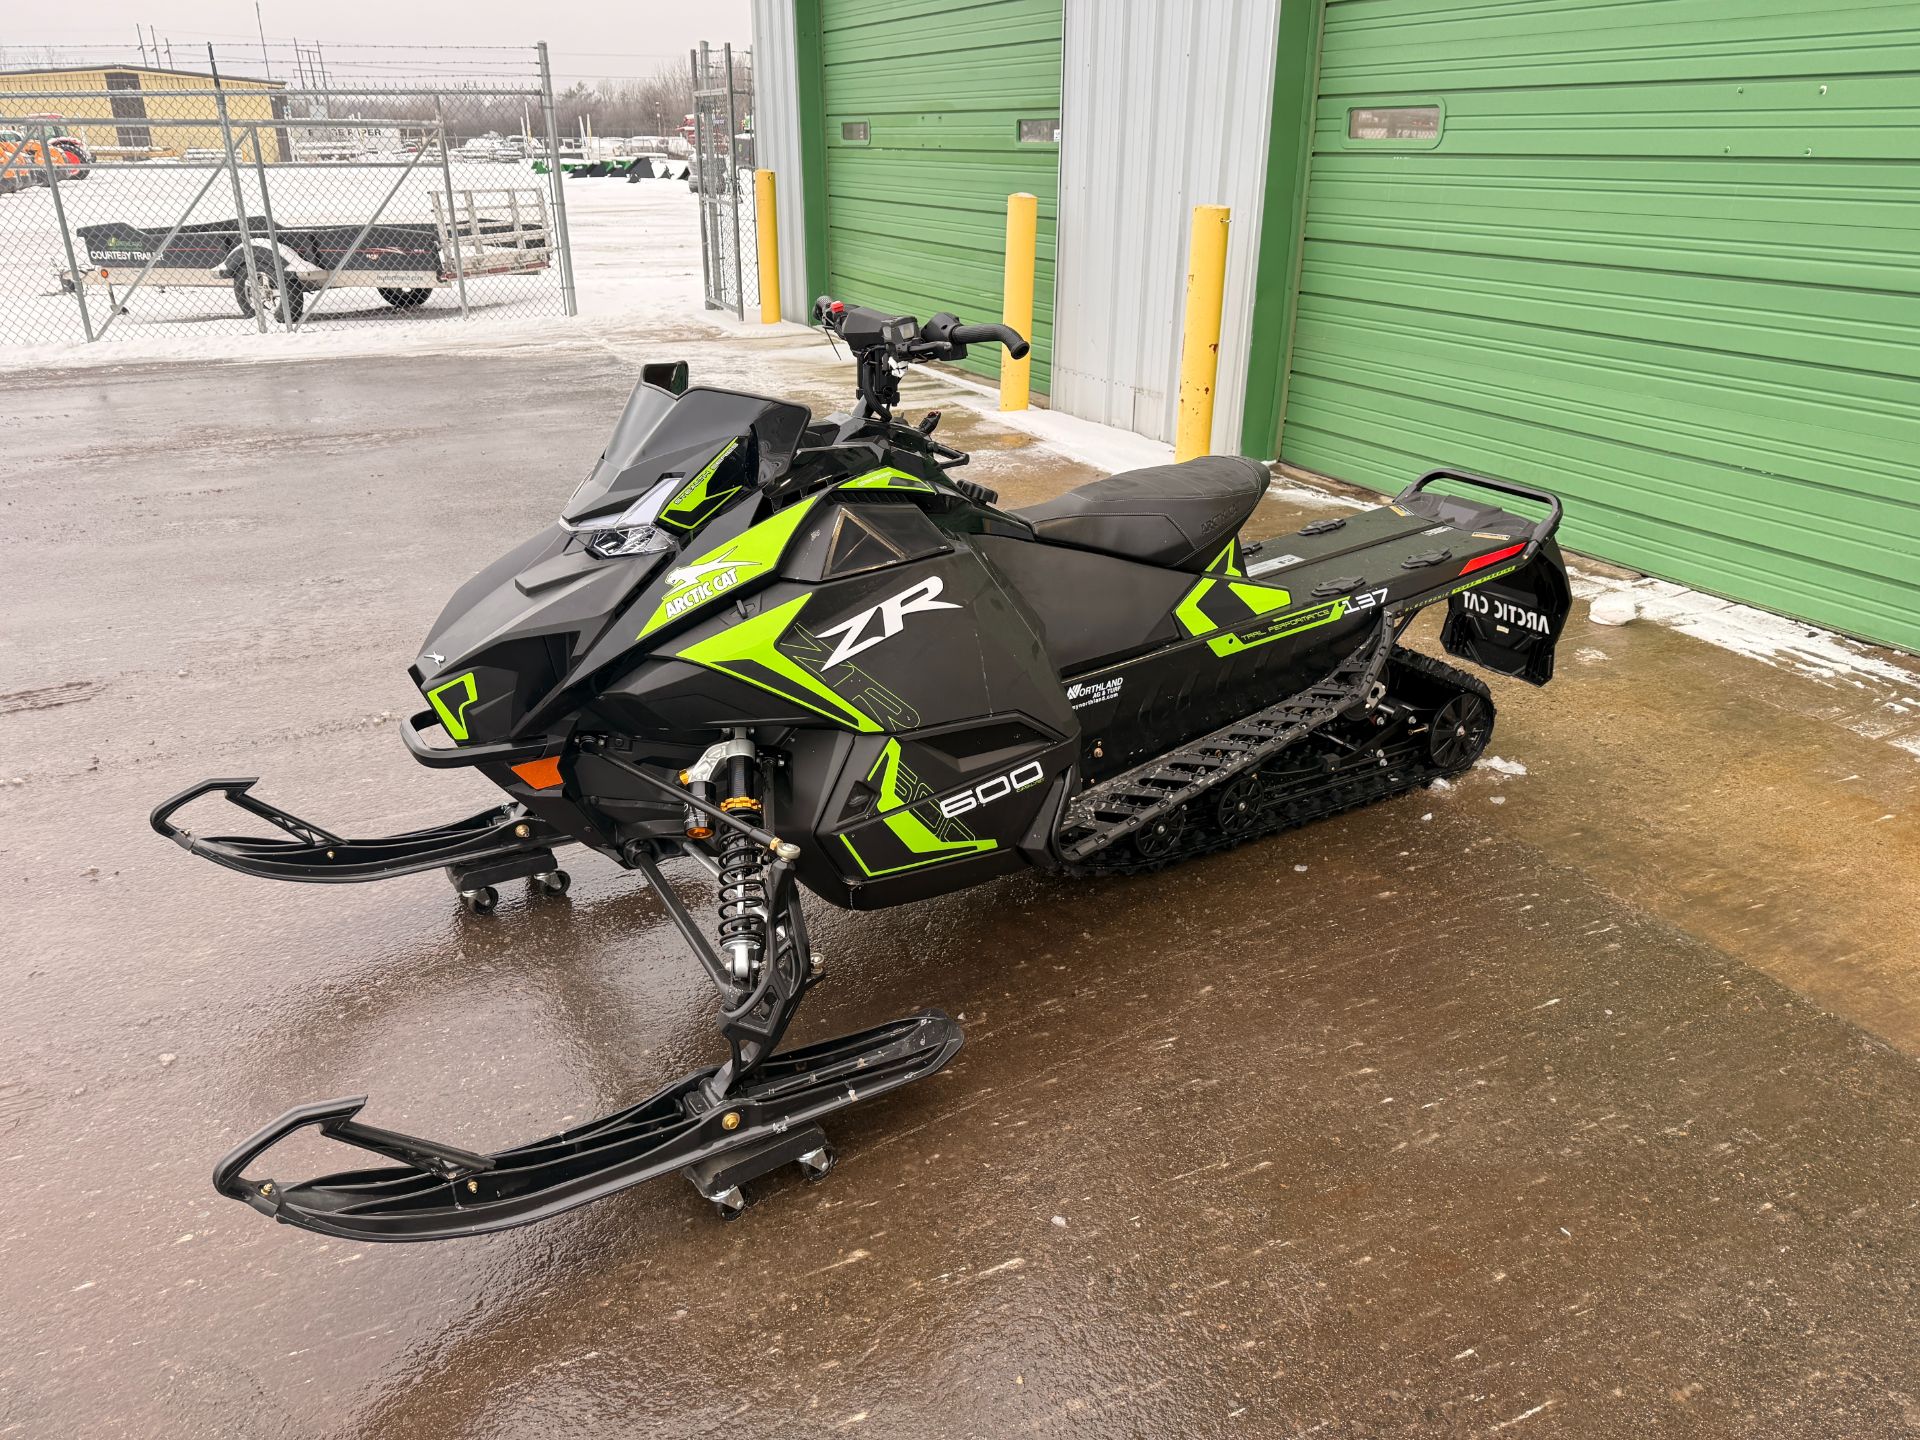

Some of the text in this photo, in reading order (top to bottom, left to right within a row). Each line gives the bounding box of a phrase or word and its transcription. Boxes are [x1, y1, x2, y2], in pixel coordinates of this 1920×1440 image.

[132, 251, 164, 261] TRAILR
[665, 567, 739, 618] ARCTIC CAT
[1342, 588, 1388, 614] 137
[814, 575, 964, 672] ZR
[1240, 609, 1330, 641] TRAIL PERFORMANCE
[1066, 677, 1124, 700] NORTHLAND
[1092, 691, 1101, 699] AG
[1107, 686, 1122, 694] TURF
[939, 760, 1044, 819] 600
